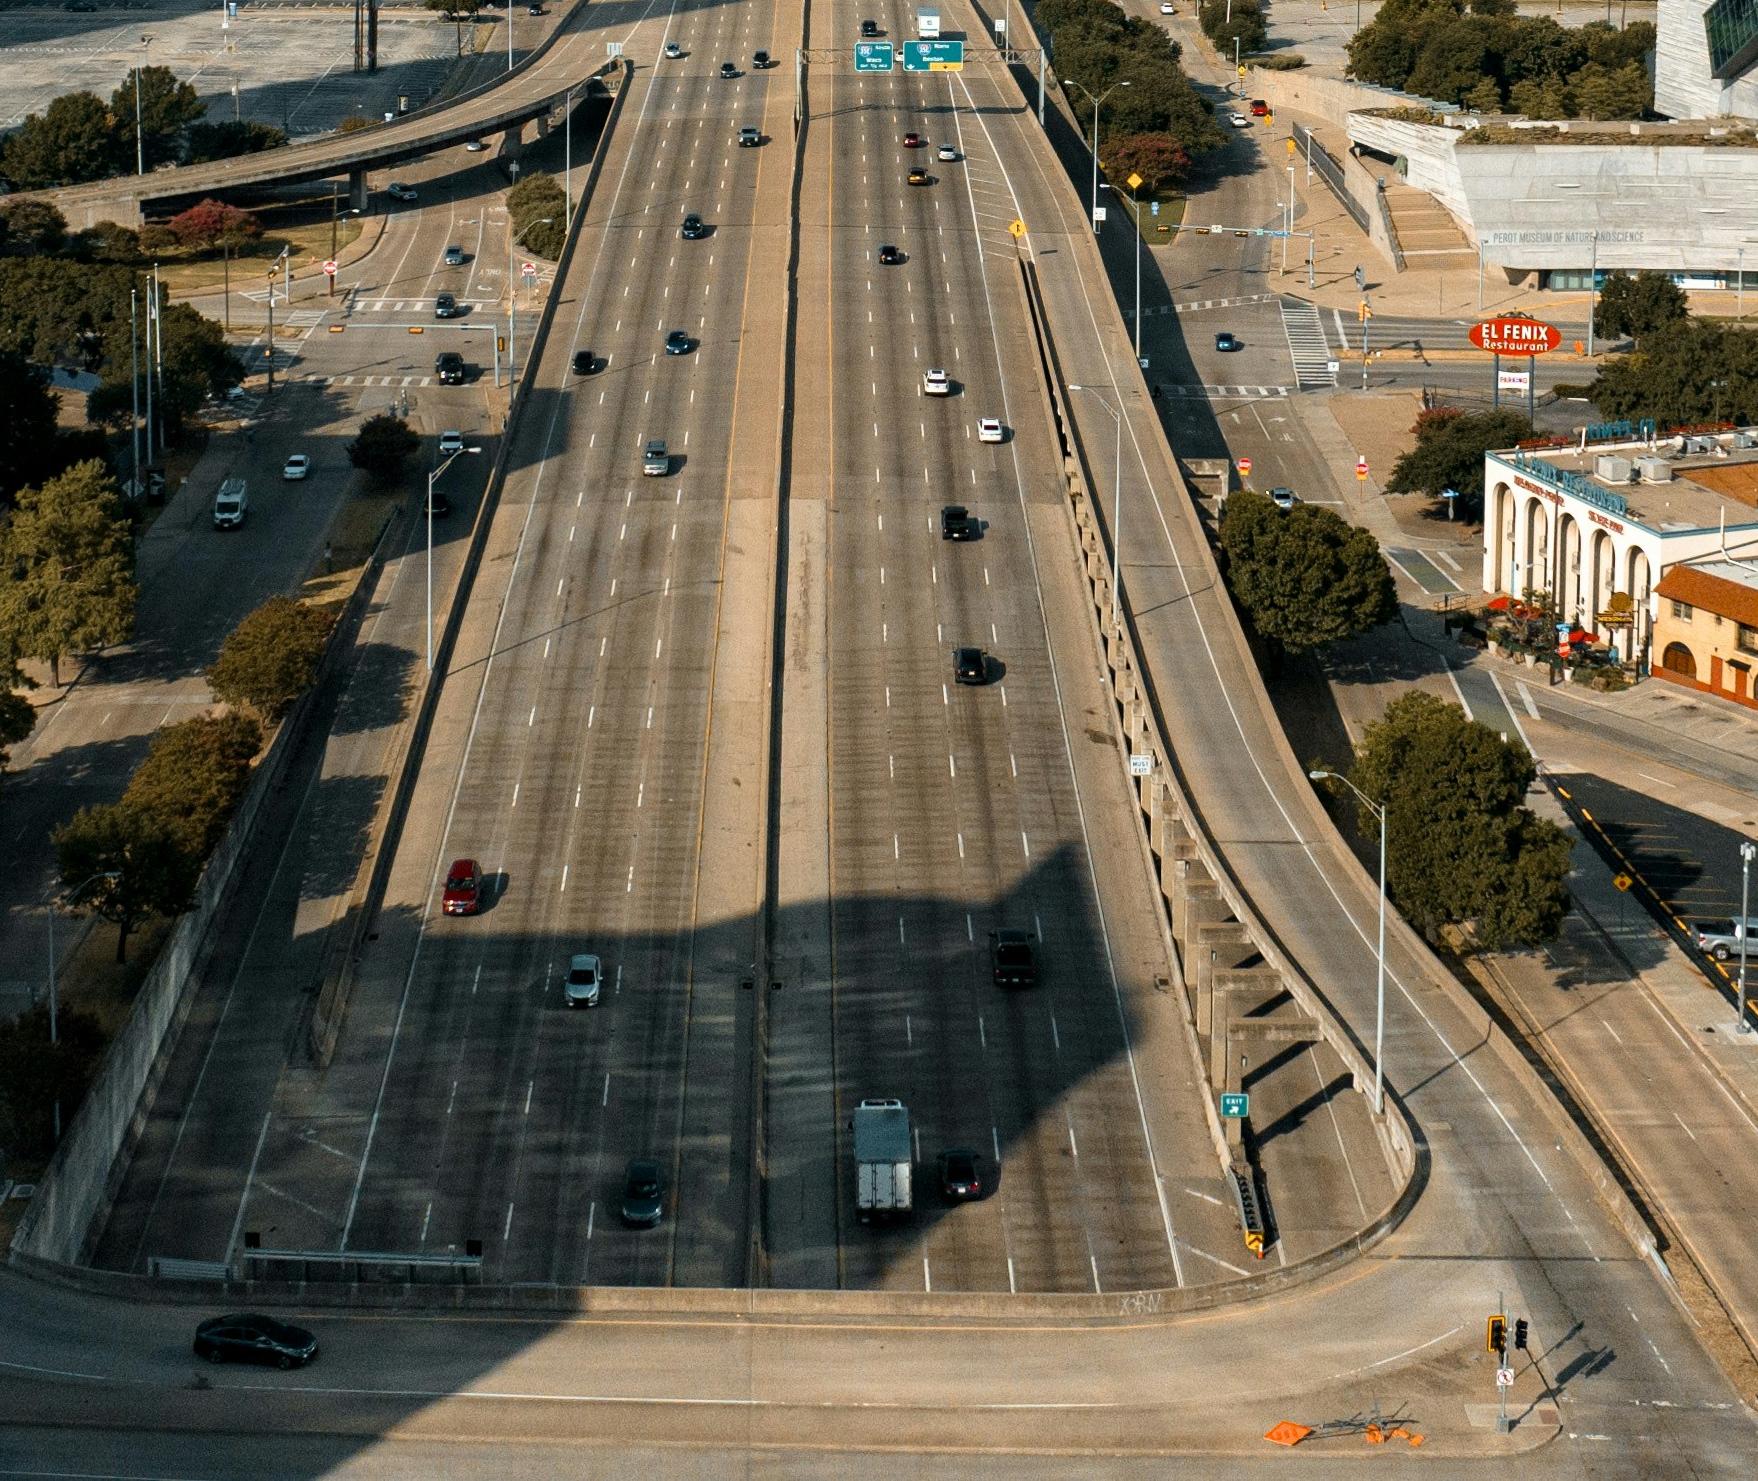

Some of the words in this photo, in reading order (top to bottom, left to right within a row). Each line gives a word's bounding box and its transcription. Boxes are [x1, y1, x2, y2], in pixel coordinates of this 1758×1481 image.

[1493, 232, 1517, 243] PEROT
[1519, 232, 1552, 243] MUSEUM
[1553, 232, 1564, 243] OF
[1565, 231, 1594, 243] NATURE
[1596, 231, 1611, 243] AND
[1611, 231, 1644, 243] SCIENCE
[1481, 323, 1498, 339] EL
[1503, 324, 1548, 341] FENIX
[1483, 338, 1549, 352] Restaurant
[1499, 376, 1528, 384] PARKING
